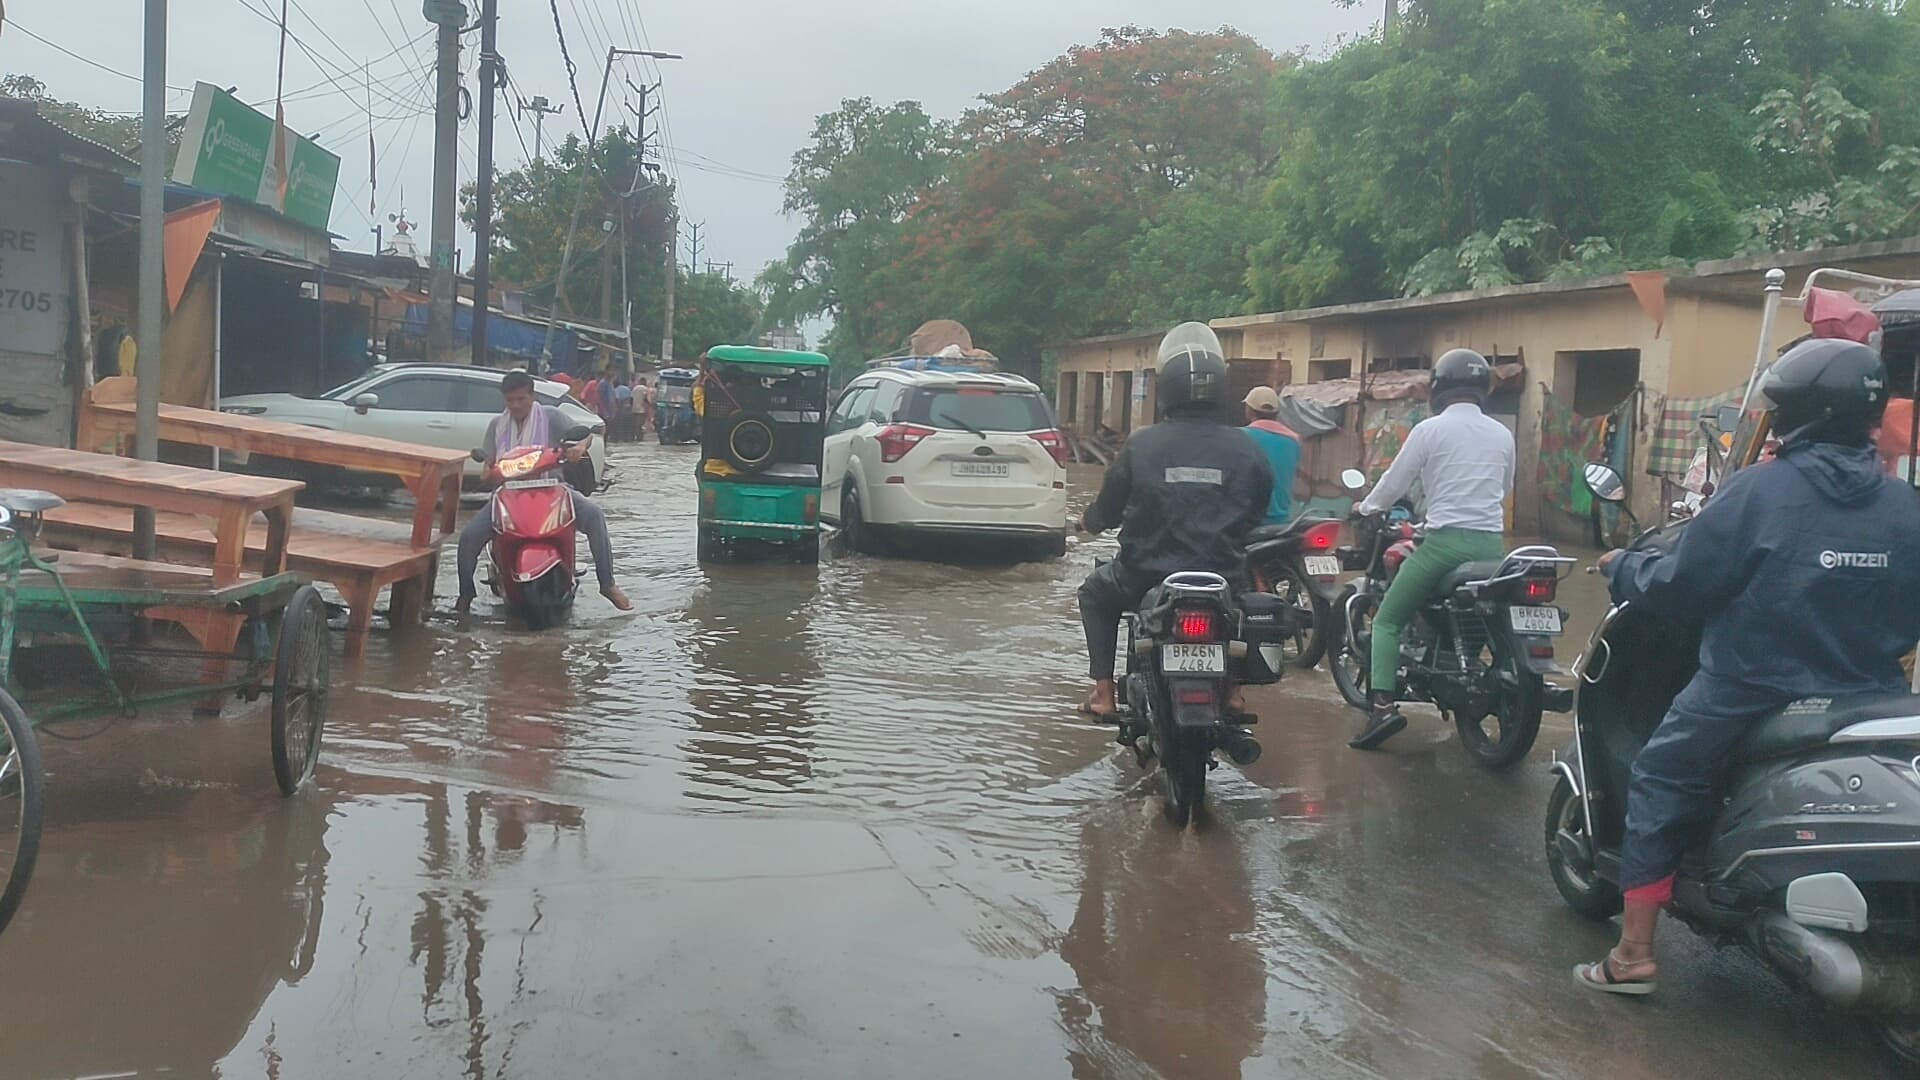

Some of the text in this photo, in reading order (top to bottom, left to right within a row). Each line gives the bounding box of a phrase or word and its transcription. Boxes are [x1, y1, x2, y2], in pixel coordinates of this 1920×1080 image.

[1820, 550, 1888, 568] CITIZEN
[1524, 619, 1552, 630] 4804
[1173, 645, 1216, 658] BR46N
[1180, 659, 1213, 672] 4484
